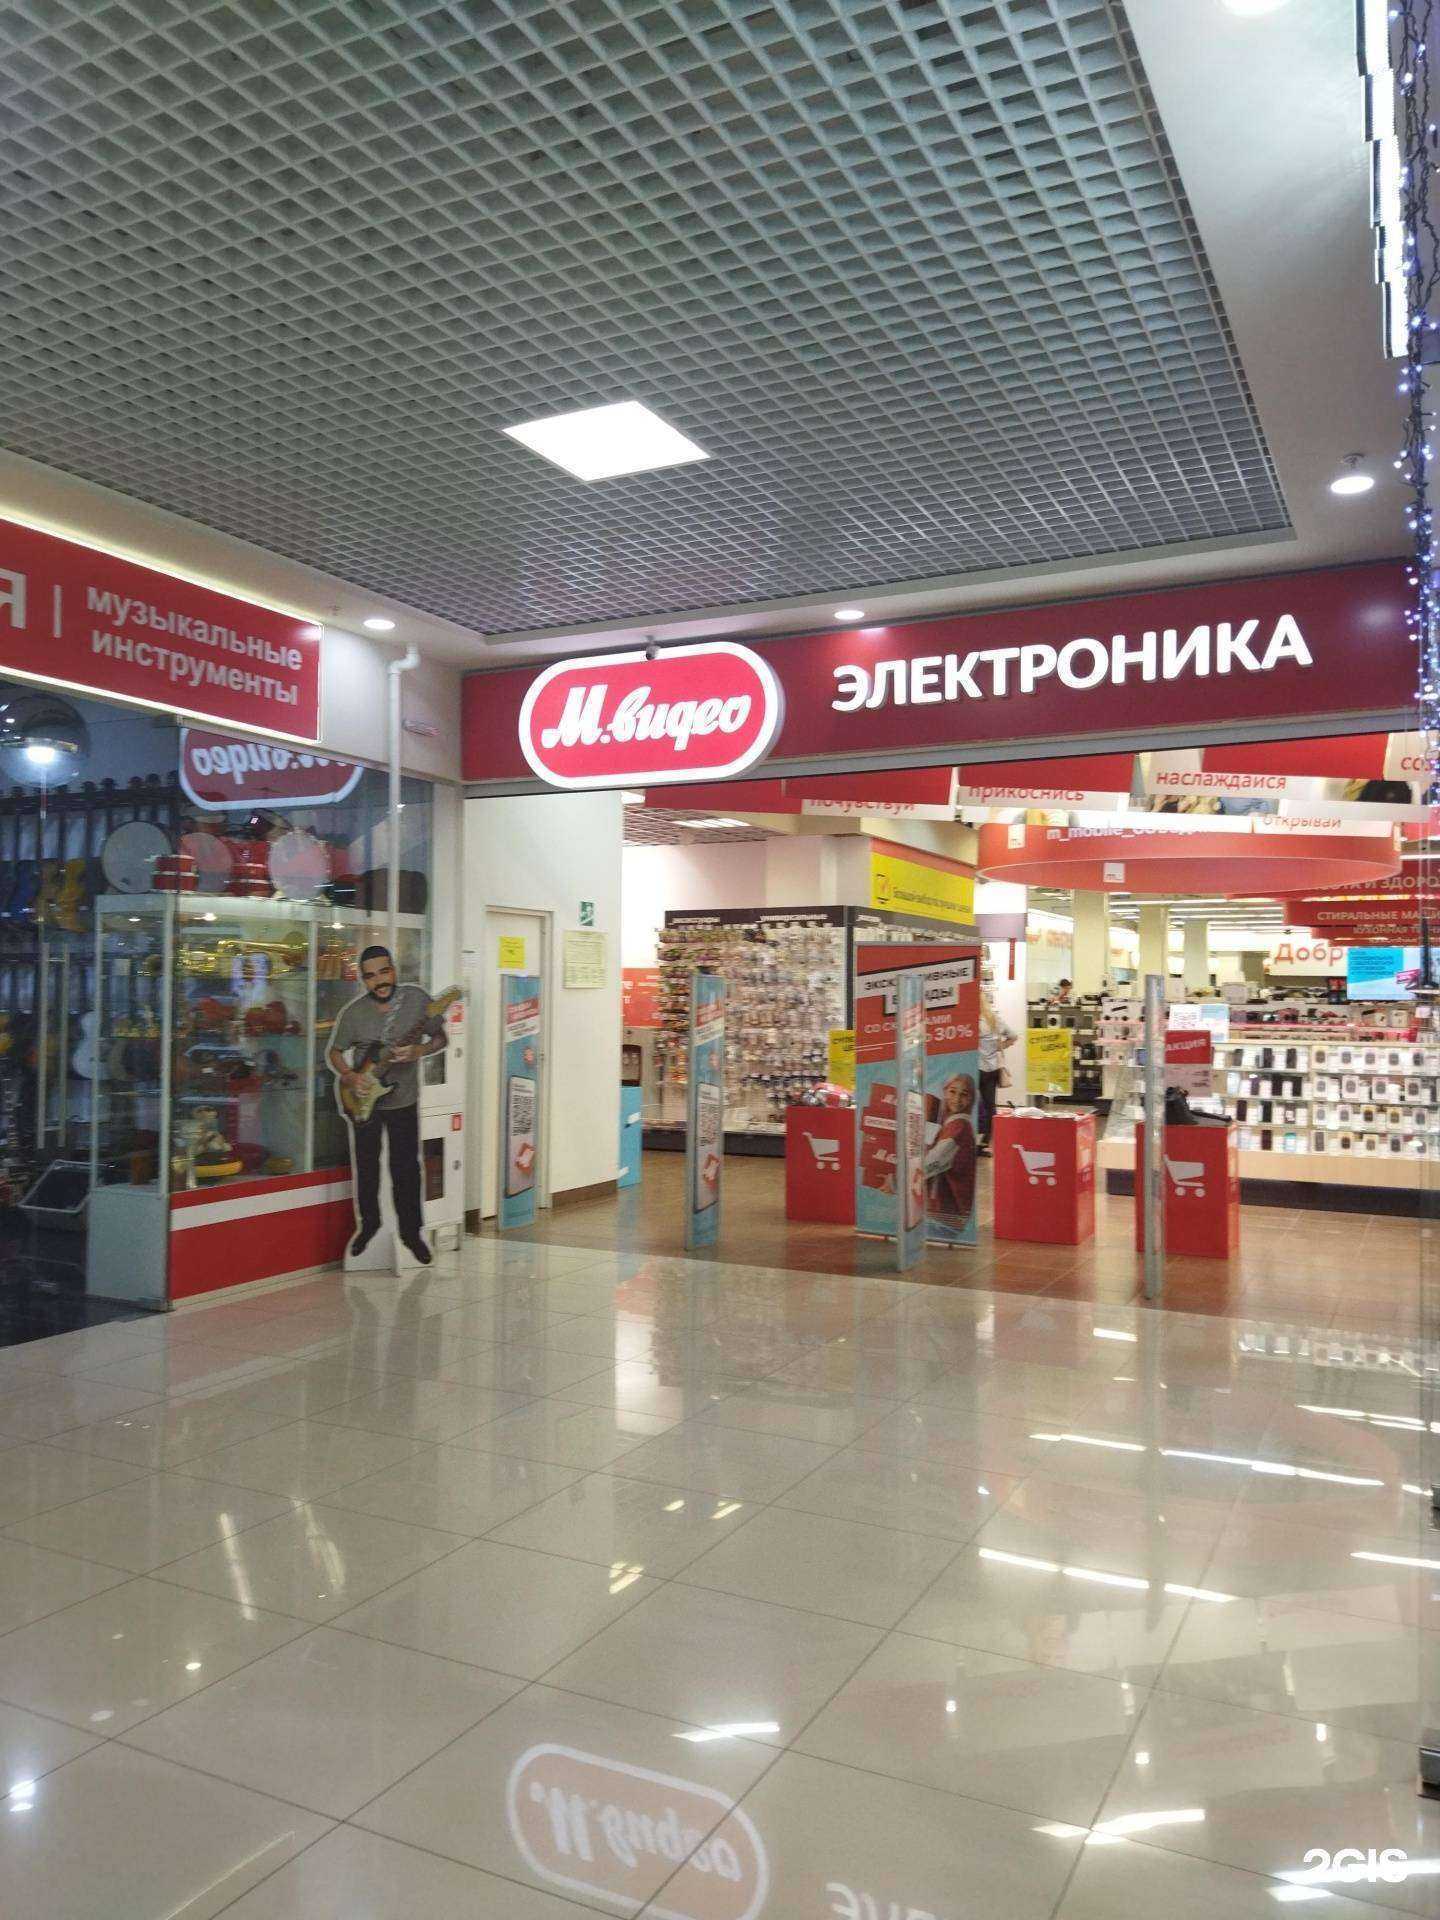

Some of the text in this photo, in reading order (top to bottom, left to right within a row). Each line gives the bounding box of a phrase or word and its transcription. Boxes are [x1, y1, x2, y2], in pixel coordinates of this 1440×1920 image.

[86, 586, 303, 671] музыкальные
[831, 614, 1313, 712] ЭЛЕКТРОНИКА
[90, 630, 299, 706] инструменты
[541, 684, 752, 751] М.видео
[1317, 911, 1398, 920] СТИРАЛЬНЫЕ
[934, 1024, 973, 1041] 30%
